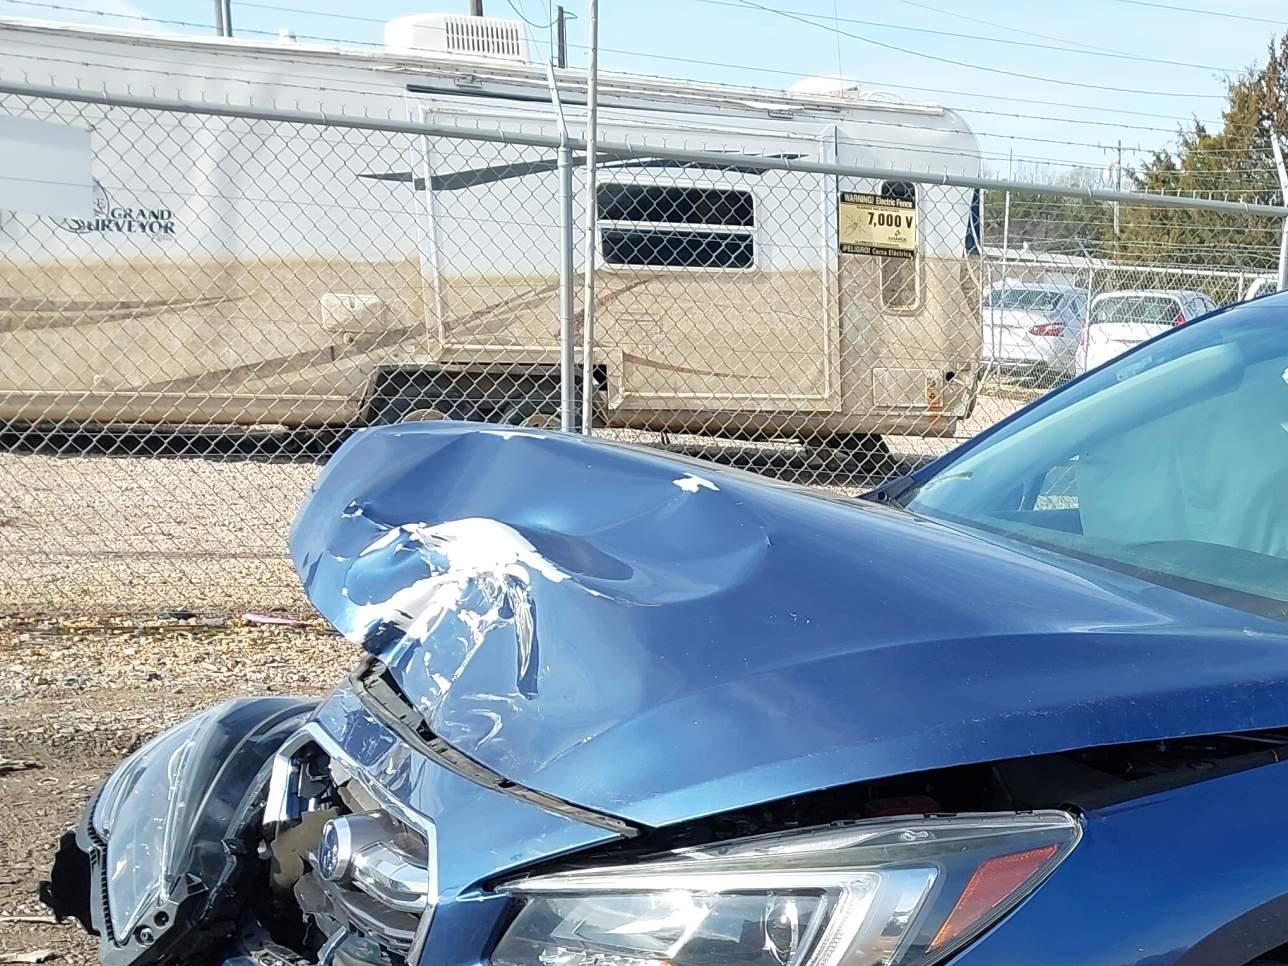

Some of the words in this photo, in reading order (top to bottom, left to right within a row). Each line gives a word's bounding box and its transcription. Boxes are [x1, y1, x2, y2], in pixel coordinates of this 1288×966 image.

[844, 193, 874, 204] WARNING!
[875, 197, 895, 206] Electric
[896, 199, 913, 208] Fence
[110, 207, 172, 221] GRAND
[867, 212, 902, 228] 7,000
[905, 216, 913, 229] V
